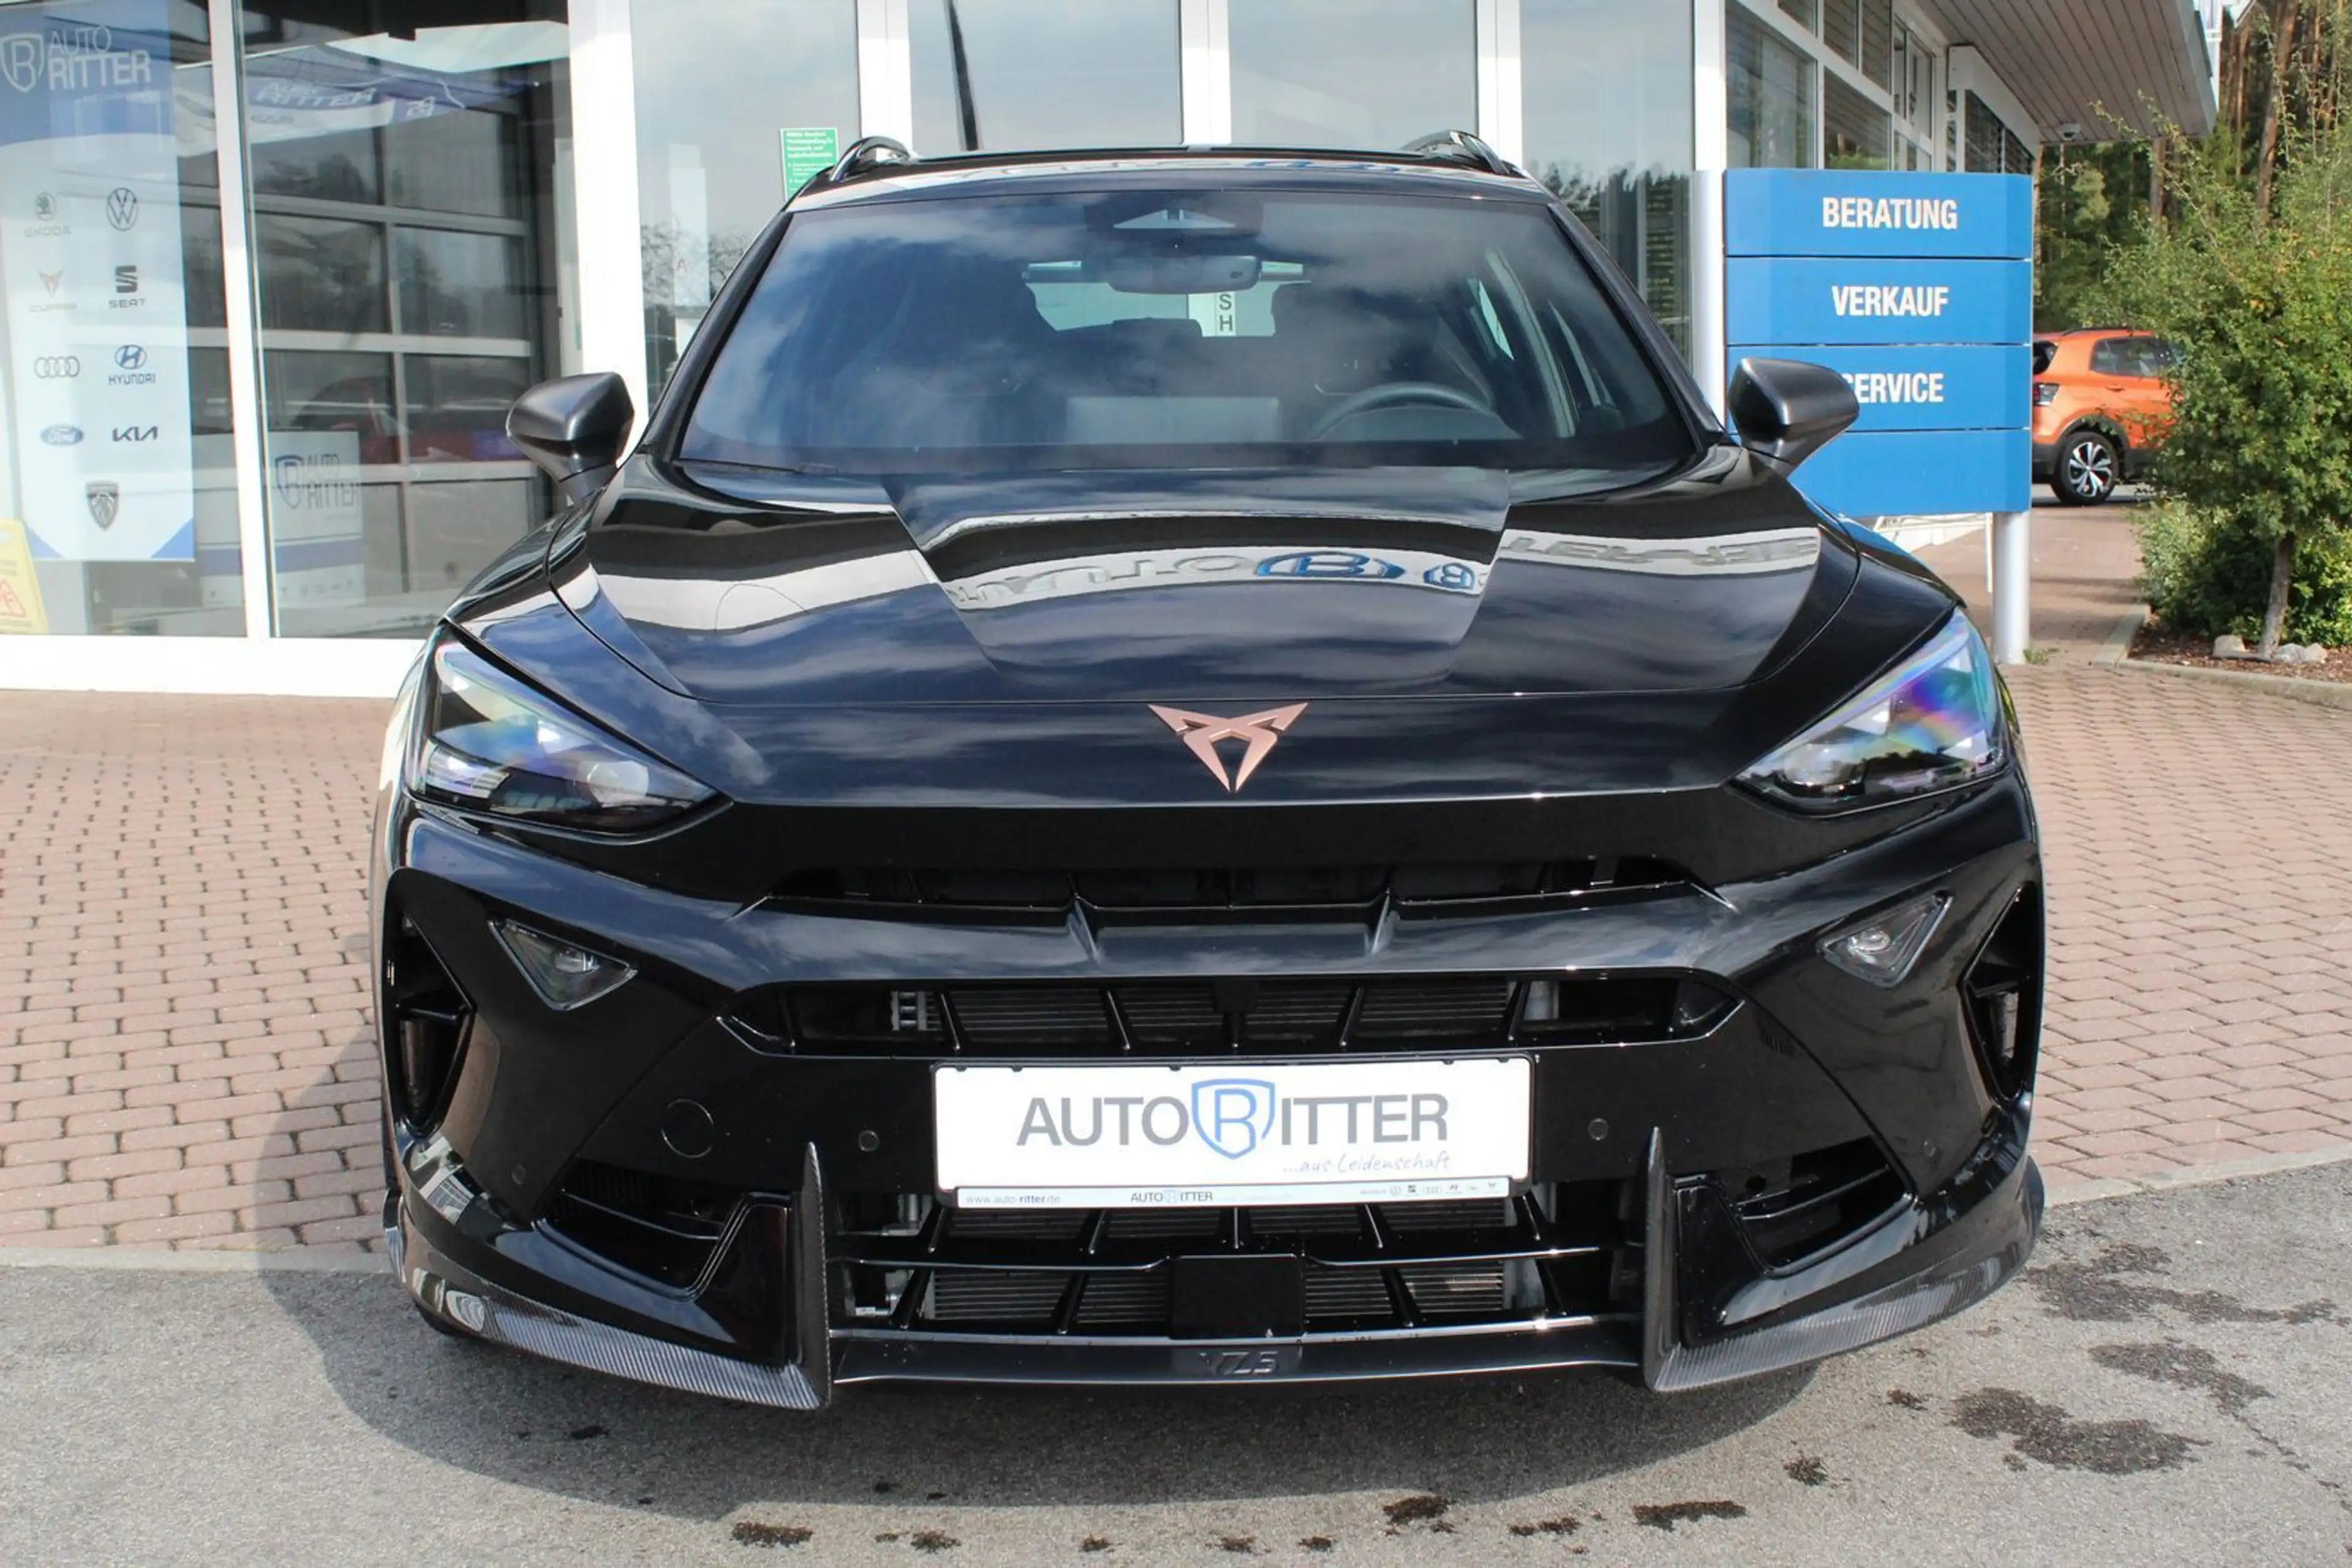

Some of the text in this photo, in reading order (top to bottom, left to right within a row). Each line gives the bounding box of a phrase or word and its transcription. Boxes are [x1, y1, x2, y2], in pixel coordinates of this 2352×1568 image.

[48, 26, 111, 56] AUTO
[48, 49, 151, 91] RITTER
[1822, 197, 1958, 229] BERATUNG
[108, 298, 146, 309] SEAT
[1831, 285, 1949, 317] VERKAUF
[108, 372, 156, 386] HYUNDAI
[112, 426, 158, 442] KIA
[1337, 1150, 1451, 1174] Leidenschaft
[966, 1194, 1060, 1204] www.auto-ritter.de
